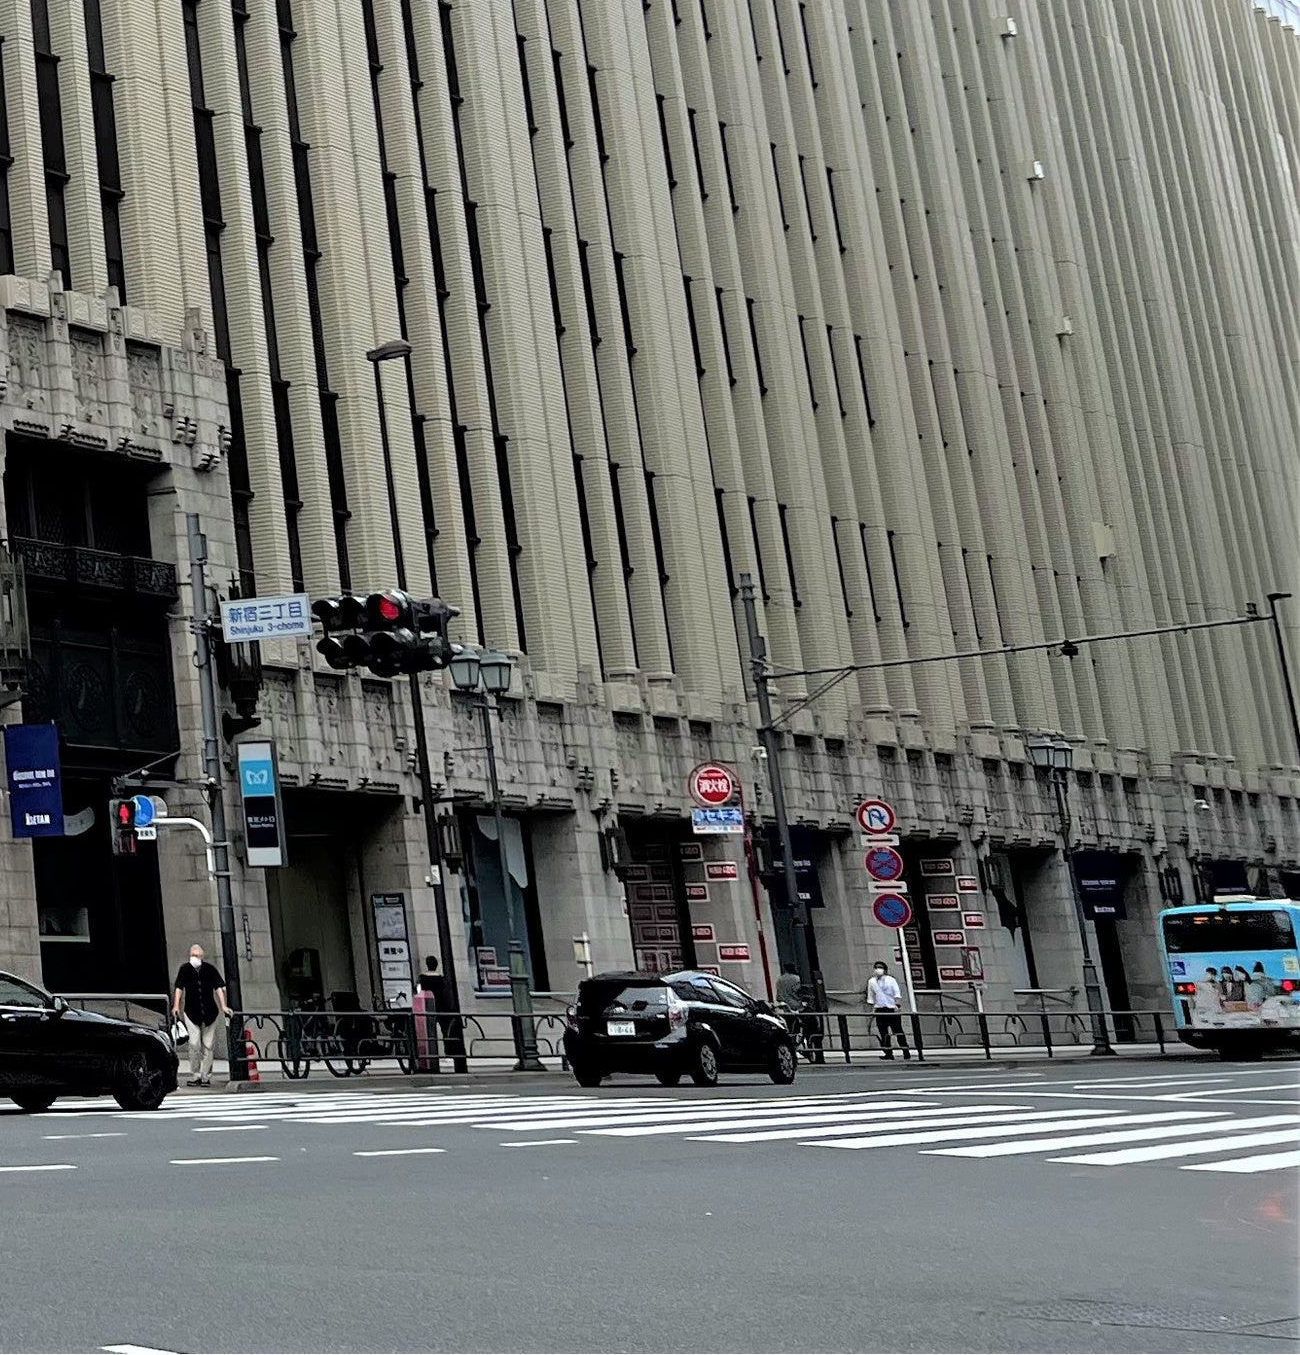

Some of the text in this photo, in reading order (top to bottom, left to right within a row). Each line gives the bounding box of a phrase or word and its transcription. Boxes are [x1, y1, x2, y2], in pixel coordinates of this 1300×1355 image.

[229, 601, 302, 623] 新宿三丁目
